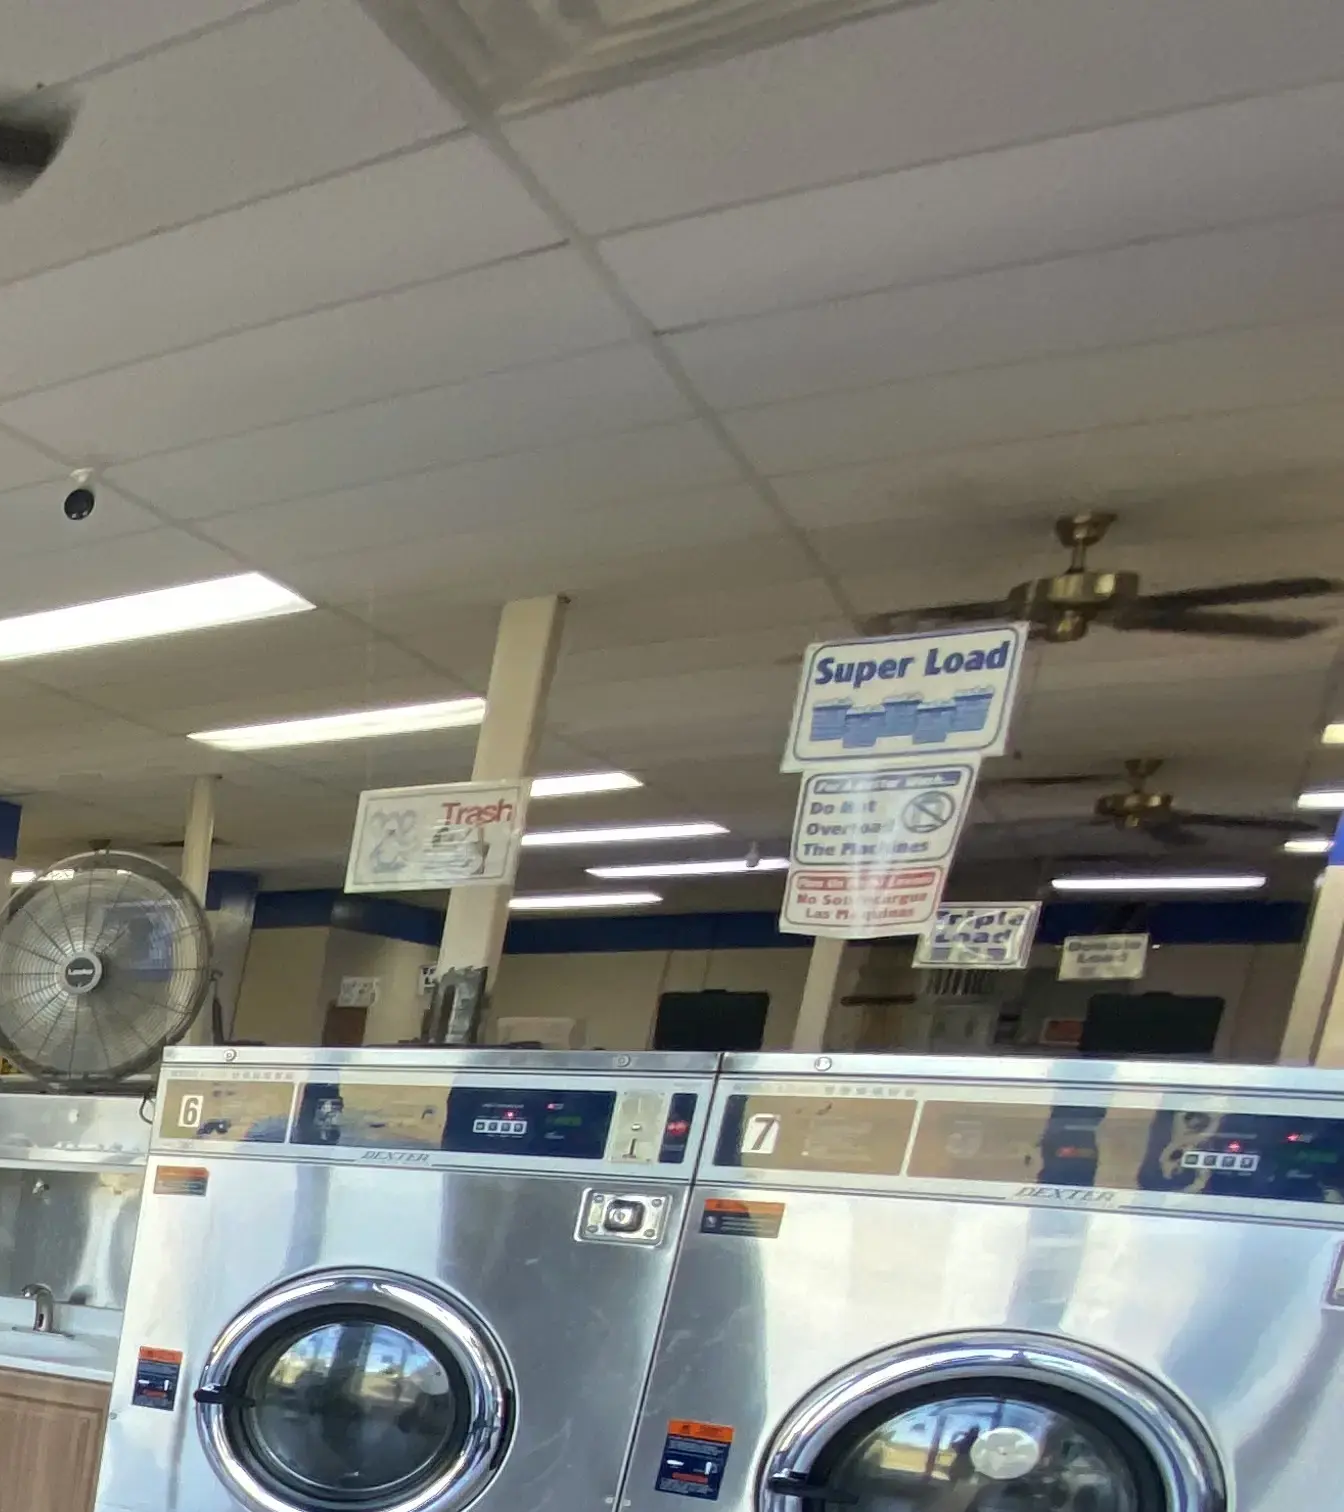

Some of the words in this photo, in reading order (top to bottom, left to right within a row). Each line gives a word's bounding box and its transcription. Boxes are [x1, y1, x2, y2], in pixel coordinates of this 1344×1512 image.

[814, 656, 915, 688] Super
[923, 640, 1011, 676] Load
[441, 798, 513, 826] Trash
[811, 802, 835, 815] Do
[804, 842, 835, 856] The
[841, 840, 929, 856] Macines
[797, 893, 818, 905] No
[822, 892, 928, 906] Sobcargue
[806, 907, 831, 919] Las
[835, 906, 914, 922] Mquinas
[936, 909, 1025, 929] Triple
[935, 928, 1012, 944] Load
[182, 1096, 200, 1126] 6
[752, 1117, 778, 1150] 7
[360, 1150, 431, 1163] DEXTER
[1014, 1187, 1115, 1202] DEXTER
